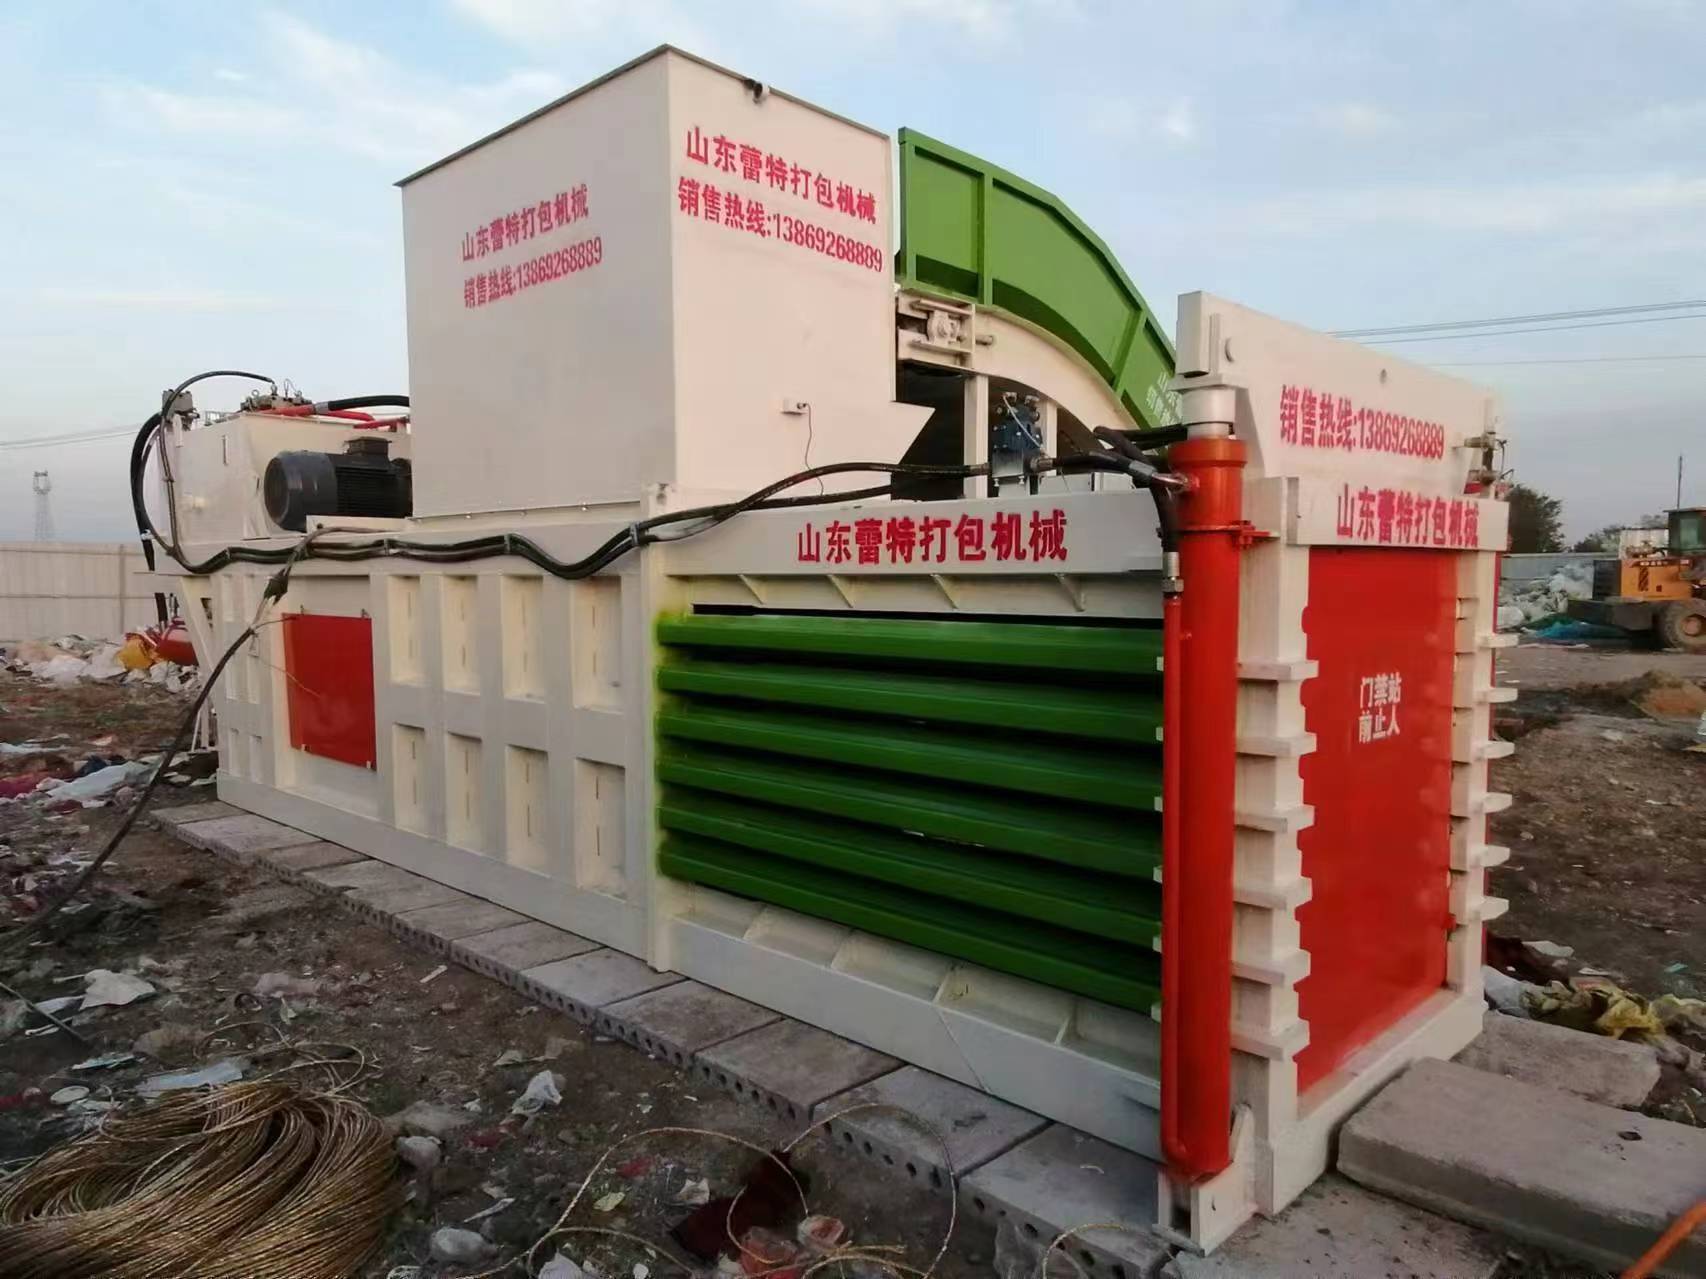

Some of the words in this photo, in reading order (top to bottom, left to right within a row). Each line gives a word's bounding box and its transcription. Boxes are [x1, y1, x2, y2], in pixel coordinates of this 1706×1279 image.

[686, 126, 876, 224] 山东蕾特打包机械
[461, 183, 589, 262] 山东蕾特打包机械
[798, 509, 1068, 565] 山东蕾特打包机械
